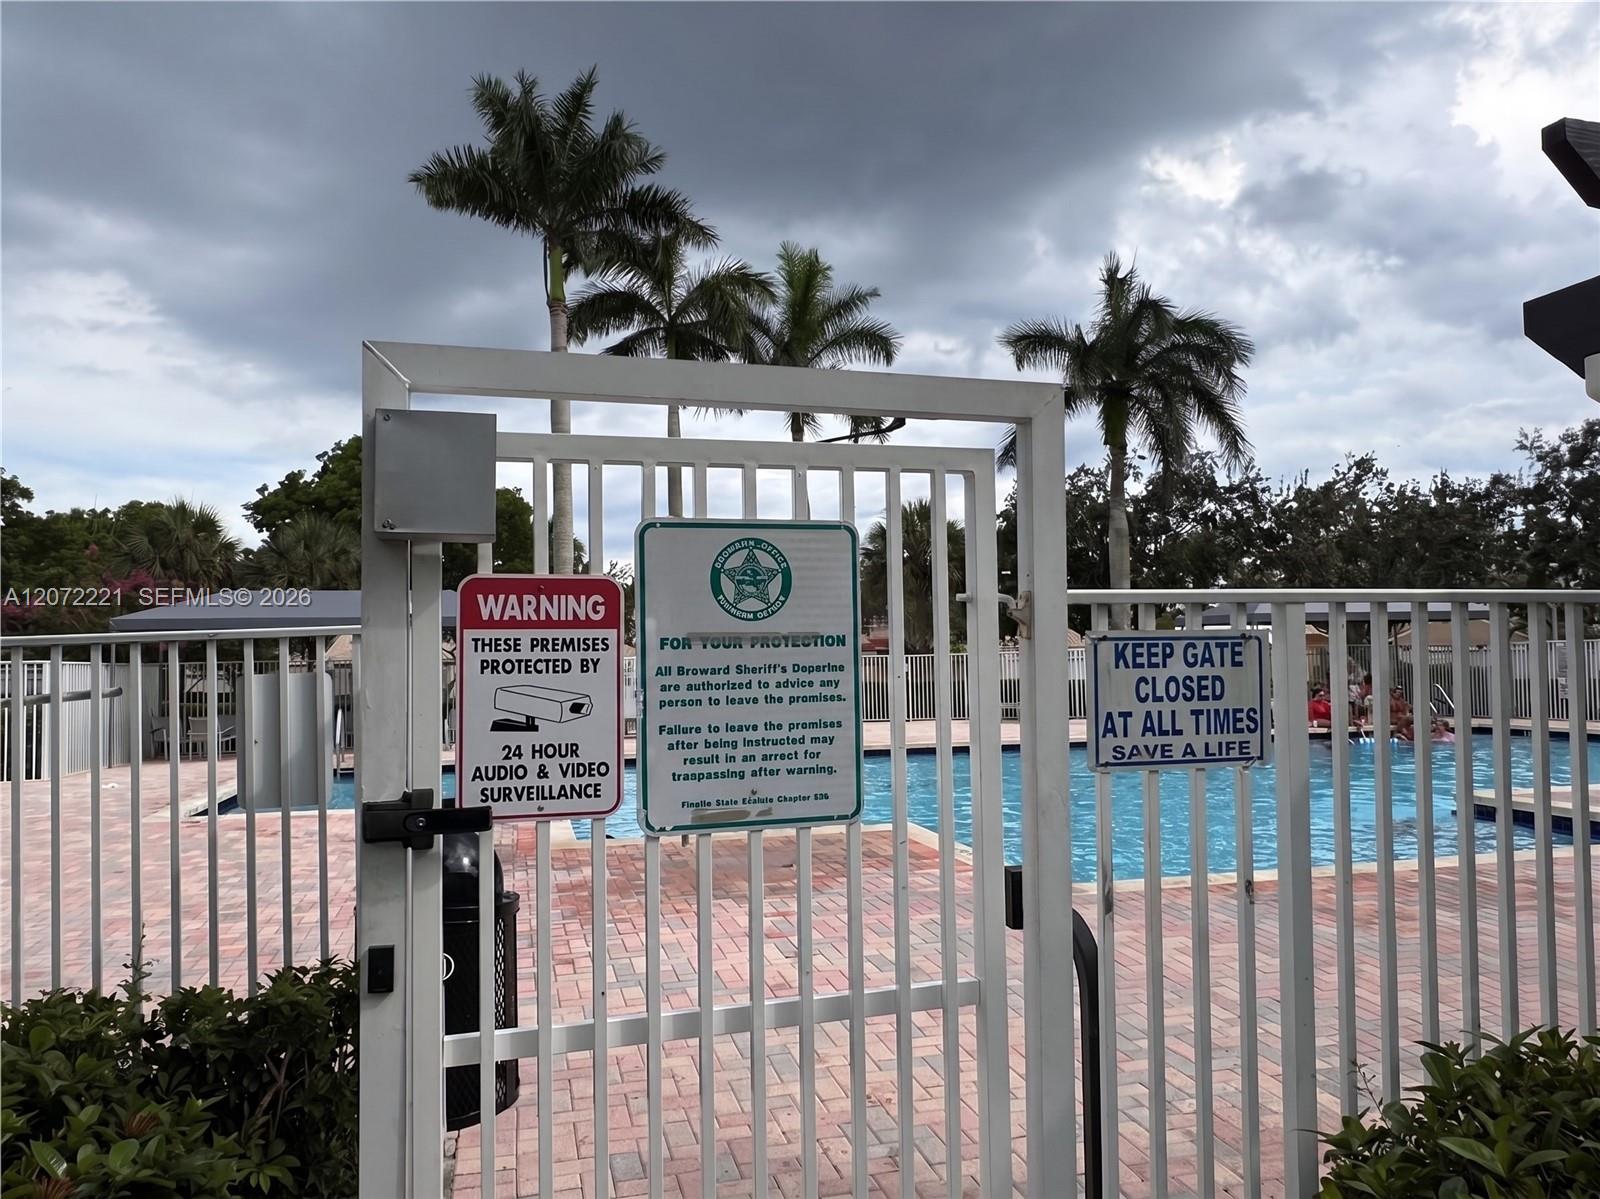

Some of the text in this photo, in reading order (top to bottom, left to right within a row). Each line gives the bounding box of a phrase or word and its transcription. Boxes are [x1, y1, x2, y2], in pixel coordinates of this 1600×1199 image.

[476, 594, 606, 621] WARNING
[471, 637, 610, 653] THESE PREMISES
[659, 637, 692, 650] FOR
[701, 636, 743, 649] YOUR
[1114, 642, 1243, 669] KEEP GATE
[480, 658, 601, 675] PROTECTED BY
[655, 665, 672, 677] All
[677, 665, 730, 676] Broward
[735, 663, 787, 675] Sheriff's
[660, 678, 840, 692] are authorized to advice any
[1135, 675, 1225, 703] CLOSED
[659, 698, 702, 710] person
[708, 697, 720, 706] to
[726, 695, 759, 705] leave
[764, 694, 784, 704] the
[658, 724, 702, 735] Failure
[707, 723, 720, 733] to
[725, 722, 758, 733] leave
[764, 721, 783, 731] the
[1102, 707, 1258, 738] AT ALL TIMES
[667, 734, 835, 751] after being instructed may
[1112, 740, 1251, 761] SAVE A LIFE
[501, 743, 580, 760] 24 HOUR
[683, 754, 720, 765] result
[725, 753, 736, 763] in
[741, 754, 756, 763] an
[803, 749, 821, 760] for
[471, 761, 610, 782] AUDIO & VIDEO
[751, 766, 781, 777] after
[786, 764, 837, 775] warning.
[480, 783, 602, 803] SURVEILLANCE
